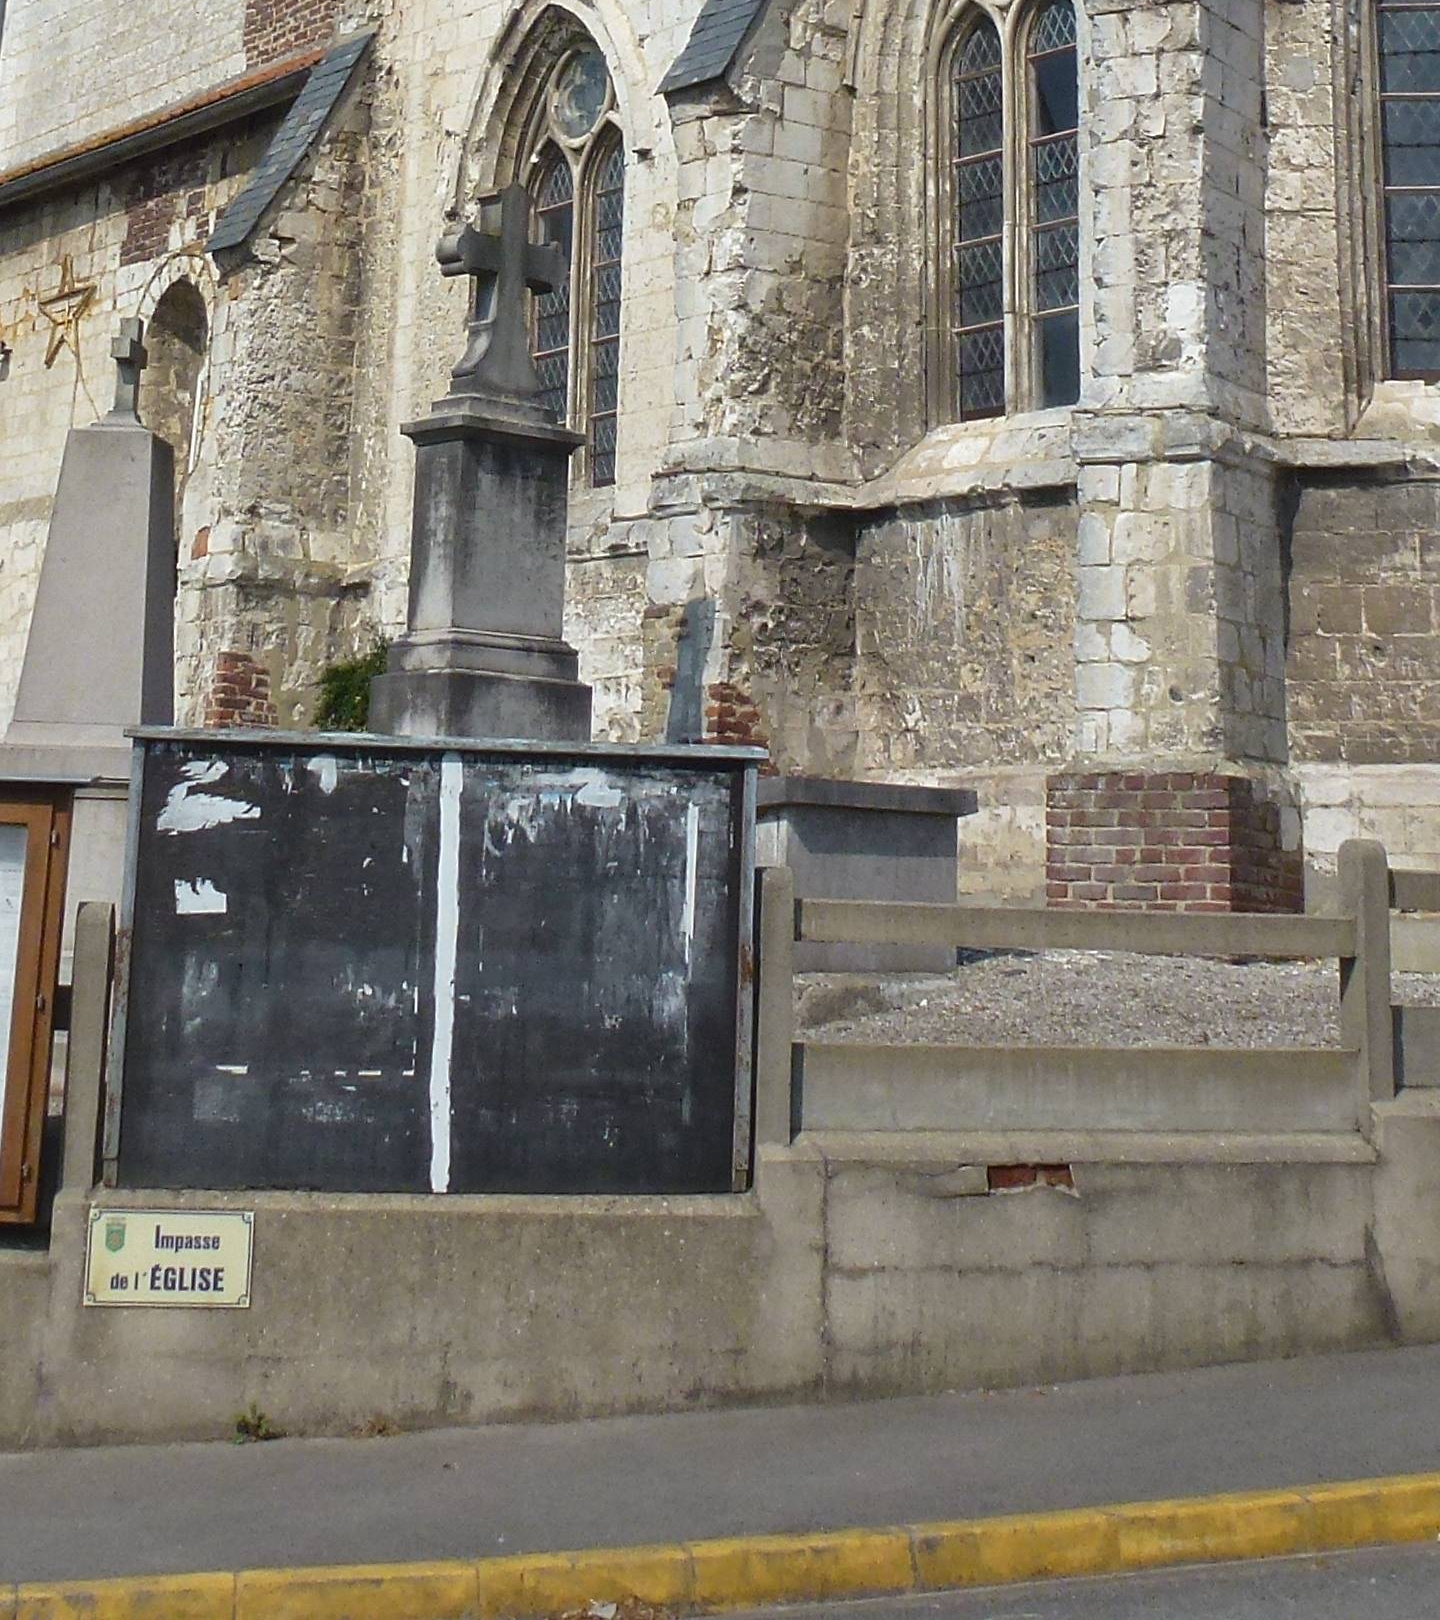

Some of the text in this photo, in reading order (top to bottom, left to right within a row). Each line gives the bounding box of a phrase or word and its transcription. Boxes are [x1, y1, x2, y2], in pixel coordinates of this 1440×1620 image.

[154, 1224, 221, 1253] Impasse
[110, 1263, 225, 1292] de l'ÉGLISE
